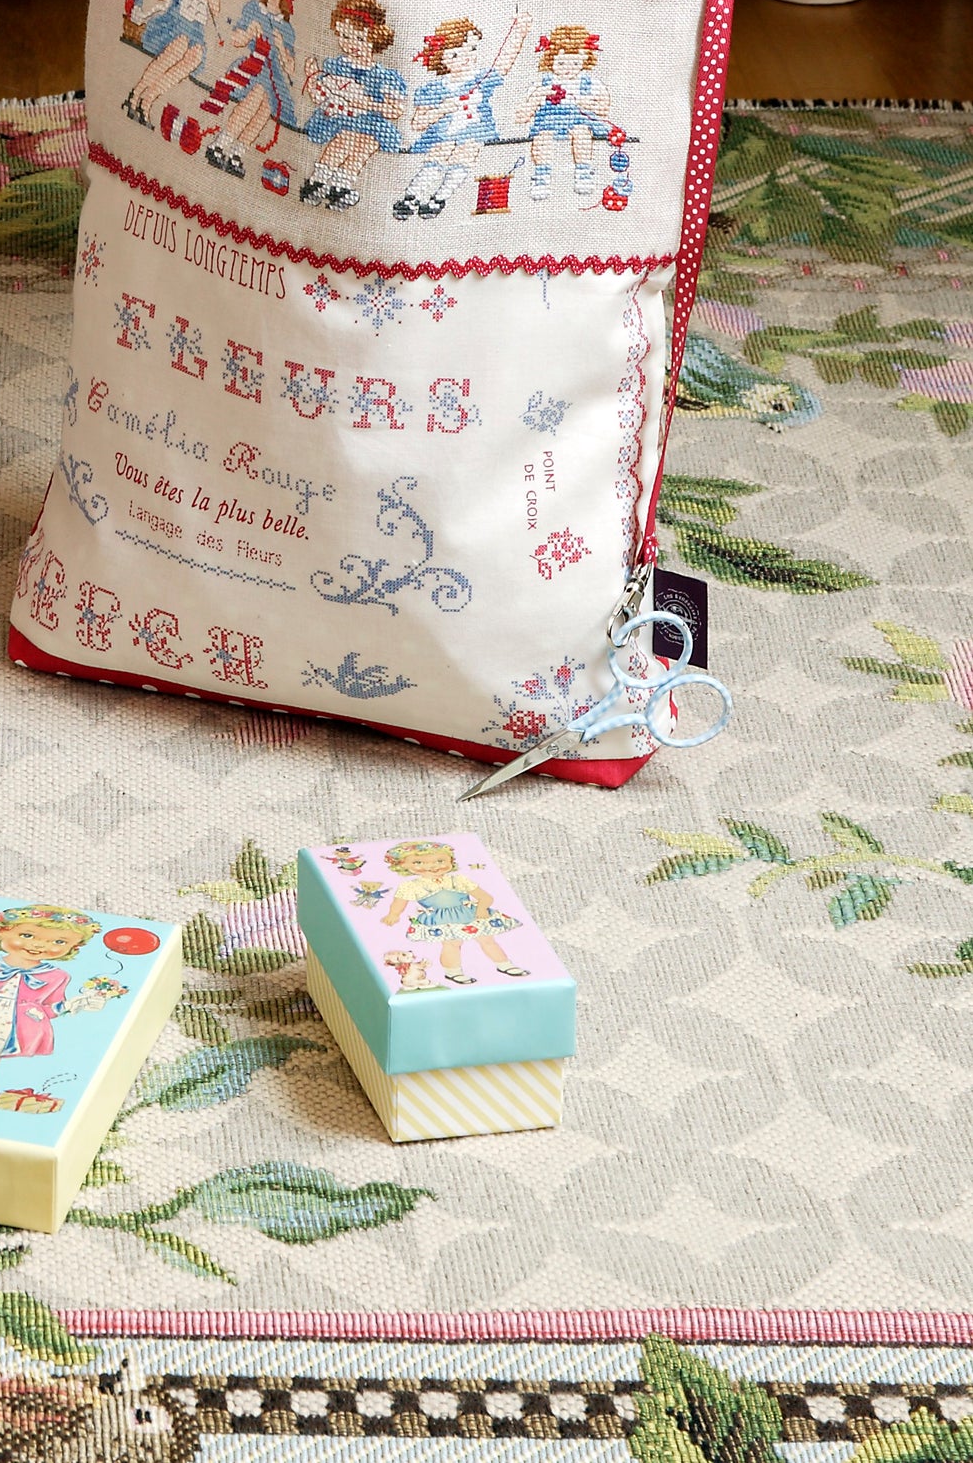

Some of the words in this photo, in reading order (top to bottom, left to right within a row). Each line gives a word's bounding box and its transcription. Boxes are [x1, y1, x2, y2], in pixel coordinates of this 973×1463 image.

[123, 199, 177, 254] DEPUIS
[184, 228, 287, 300] LONGTEMPS
[114, 291, 482, 434] FLEURS
[87, 376, 209, 462] Camélia
[222, 441, 337, 515] Rouge
[523, 464, 536, 482] DE
[542, 450, 556, 492] POINT
[115, 451, 149, 488] Vous
[153, 475, 185, 504] êtes
[191, 486, 211, 512] la
[213, 498, 256, 525] plus
[261, 508, 310, 541] belle.
[128, 499, 184, 539] Langage
[195, 529, 224, 552] des
[525, 490, 538, 530] CROIX
